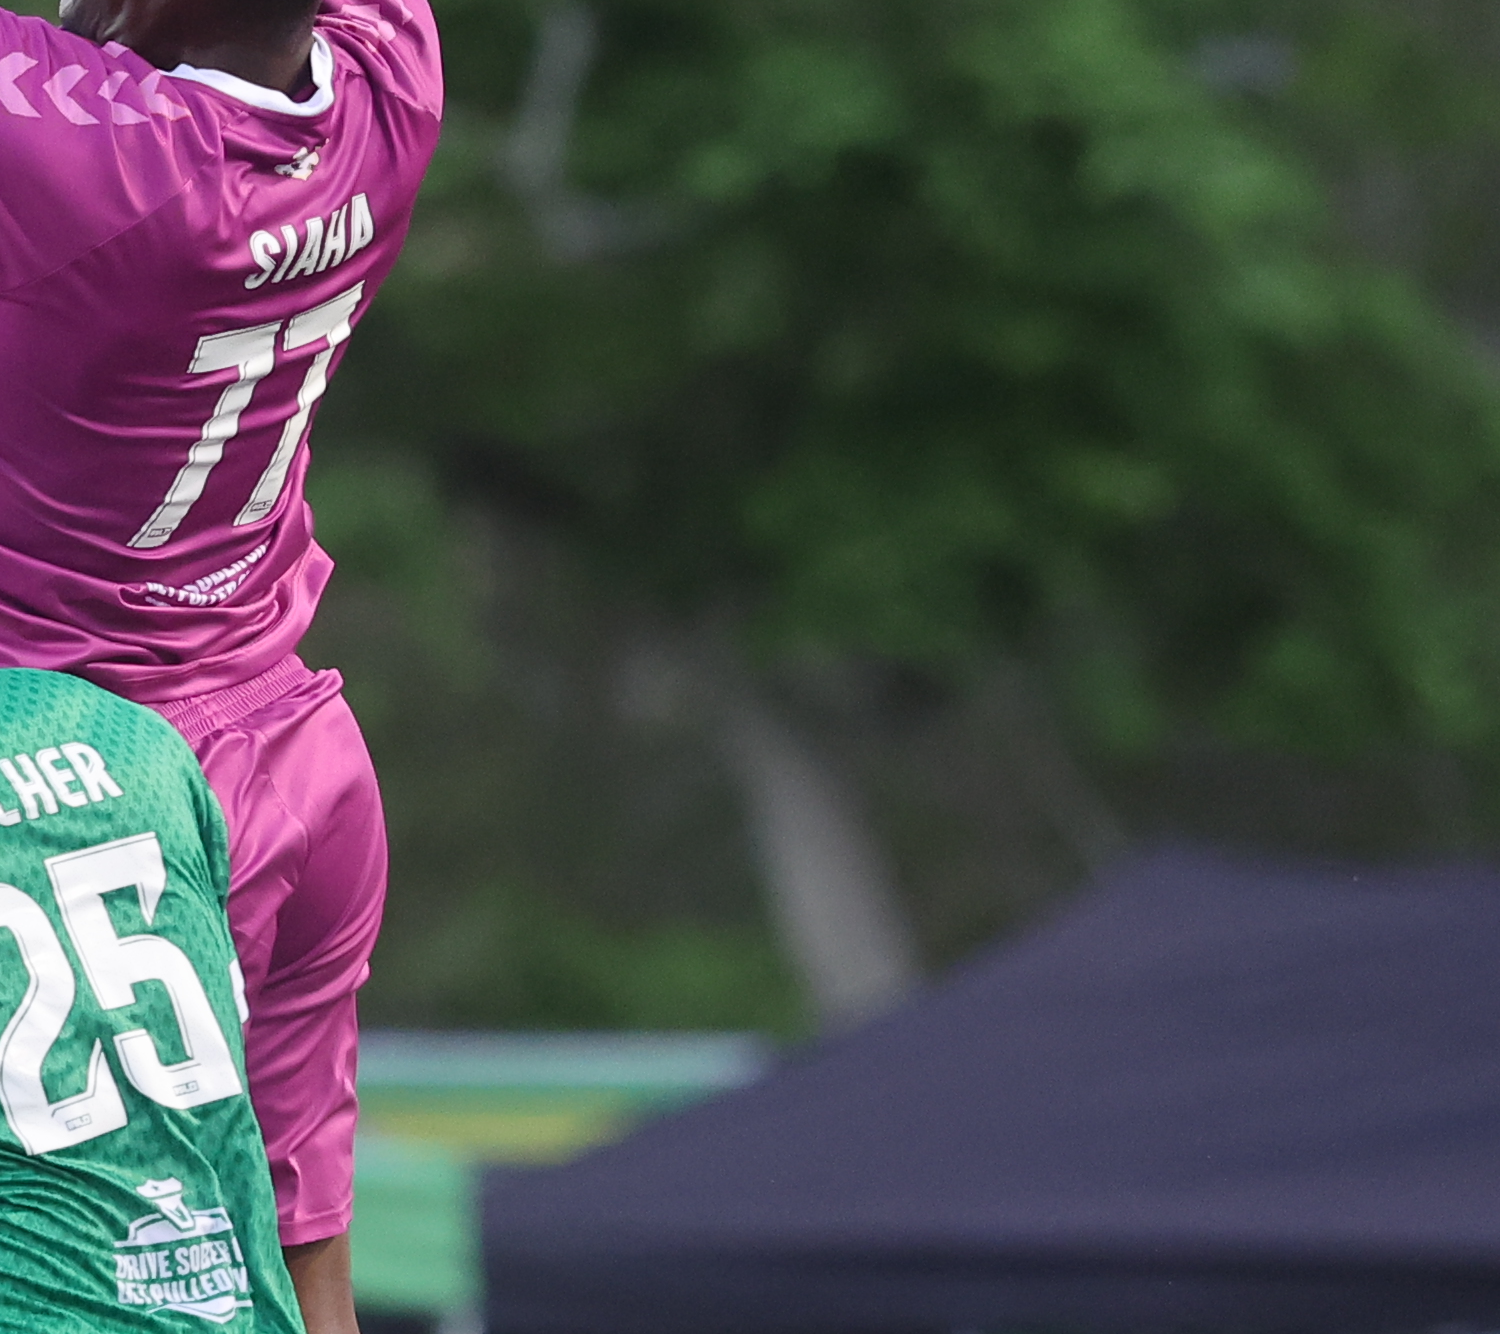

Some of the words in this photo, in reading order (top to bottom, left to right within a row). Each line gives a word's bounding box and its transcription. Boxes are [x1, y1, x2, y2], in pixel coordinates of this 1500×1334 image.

[244, 192, 375, 290] SIAHA
[126, 279, 366, 549] 77
[112, 1250, 173, 1280] DRIVE
[174, 1240, 232, 1276] SOBER
